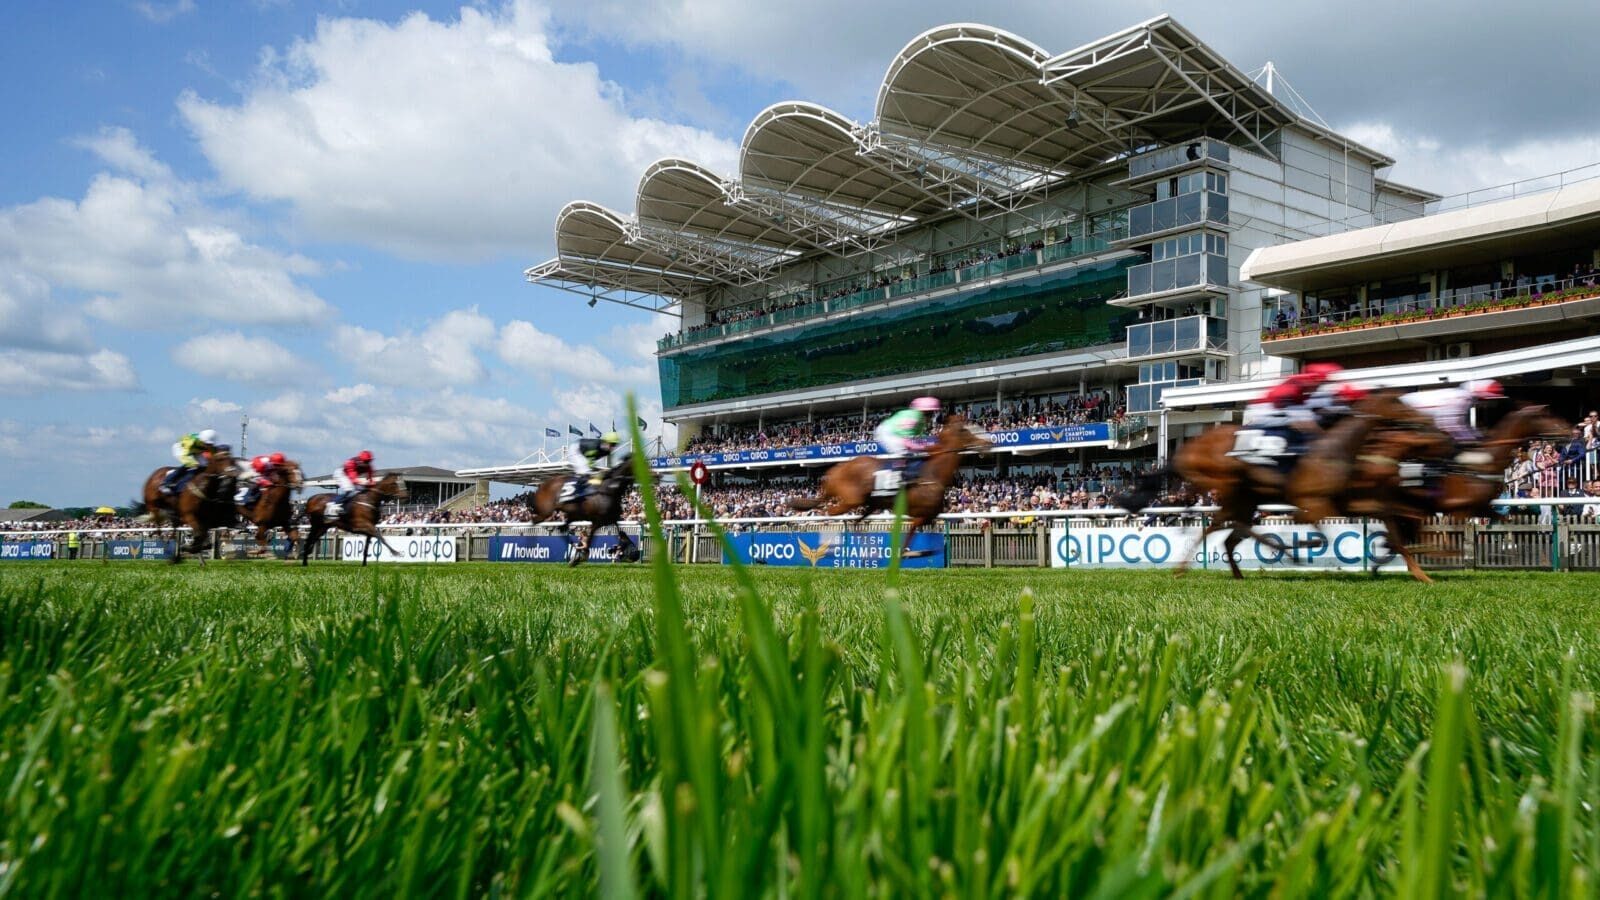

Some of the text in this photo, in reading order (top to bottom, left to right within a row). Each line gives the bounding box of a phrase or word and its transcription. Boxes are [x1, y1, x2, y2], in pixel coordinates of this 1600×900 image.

[820, 446, 842, 456] QIPCO
[856, 443, 878, 454] QIPCO
[514, 543, 550, 559] howden
[749, 543, 795, 559] QIPCO
[1057, 533, 1171, 564] QIPCO
